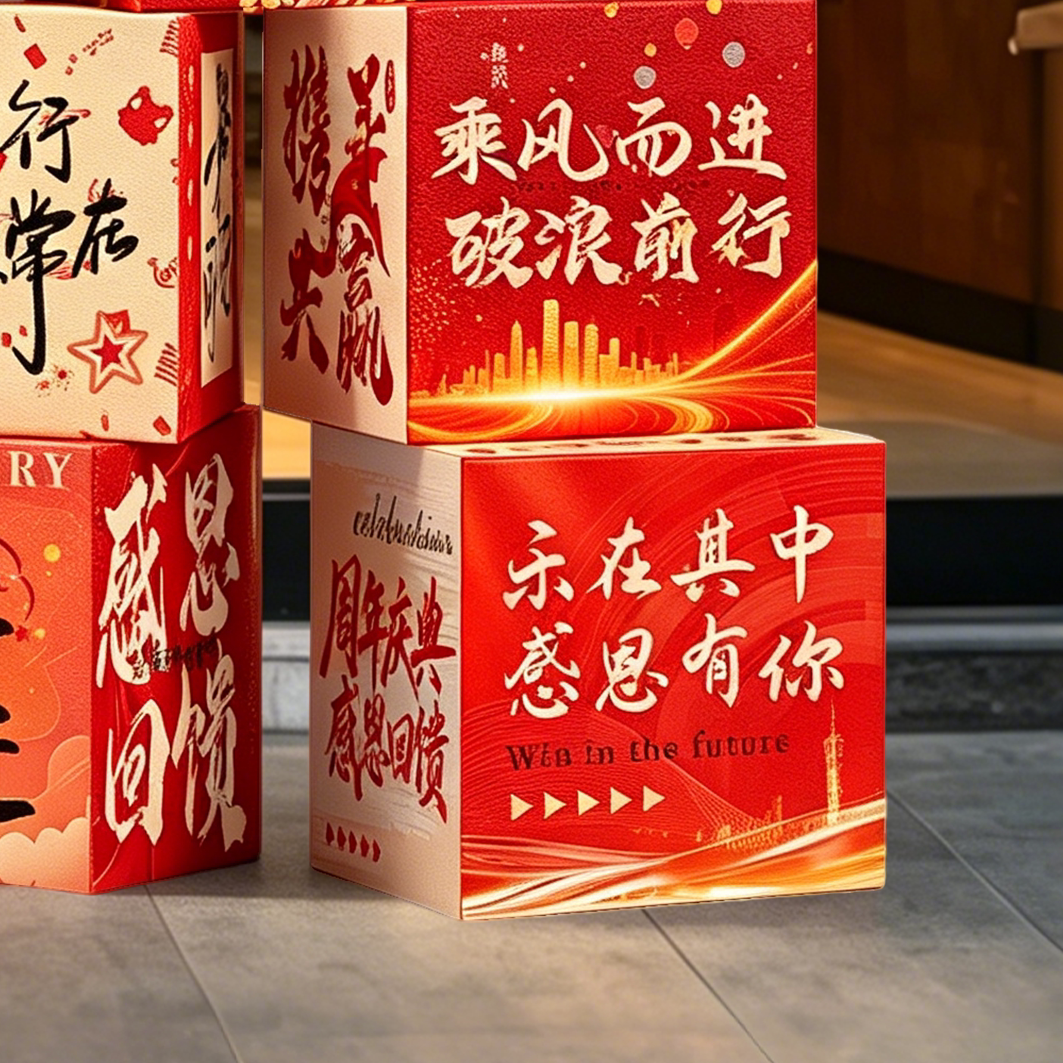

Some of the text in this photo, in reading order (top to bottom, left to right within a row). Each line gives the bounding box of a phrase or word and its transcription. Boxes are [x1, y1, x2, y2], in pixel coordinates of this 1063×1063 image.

[430, 93, 788, 185] 乘风而进
[445, 189, 793, 290] 破浪前行
[95, 451, 241, 689] 感恩
[504, 612, 845, 719] 感恩有你
[586, 739, 615, 765] in
[629, 737, 679, 763] the
